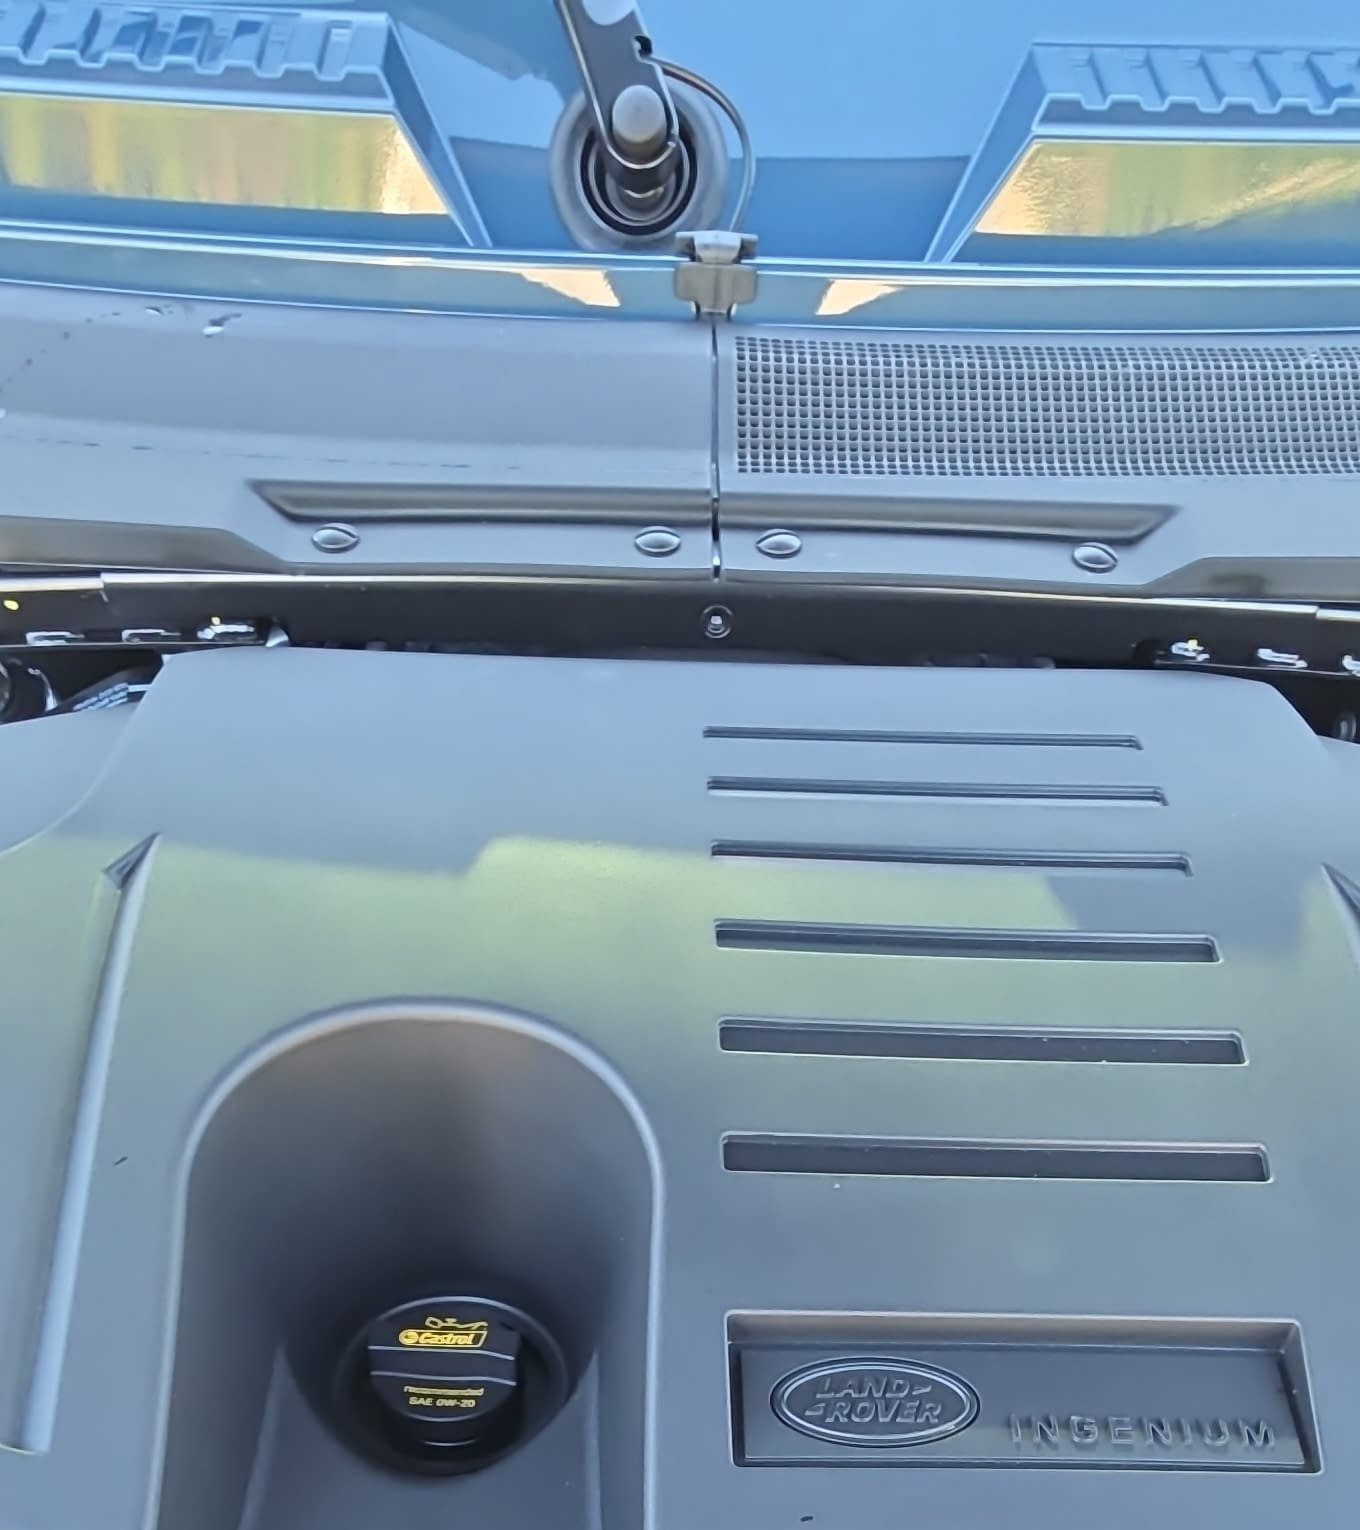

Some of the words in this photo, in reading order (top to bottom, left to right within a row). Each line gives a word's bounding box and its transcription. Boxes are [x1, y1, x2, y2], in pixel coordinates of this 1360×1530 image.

[417, 1332, 475, 1345] Castrol
[408, 1396, 434, 1406] SAE
[1007, 1412, 1278, 1450] INGENIUM
